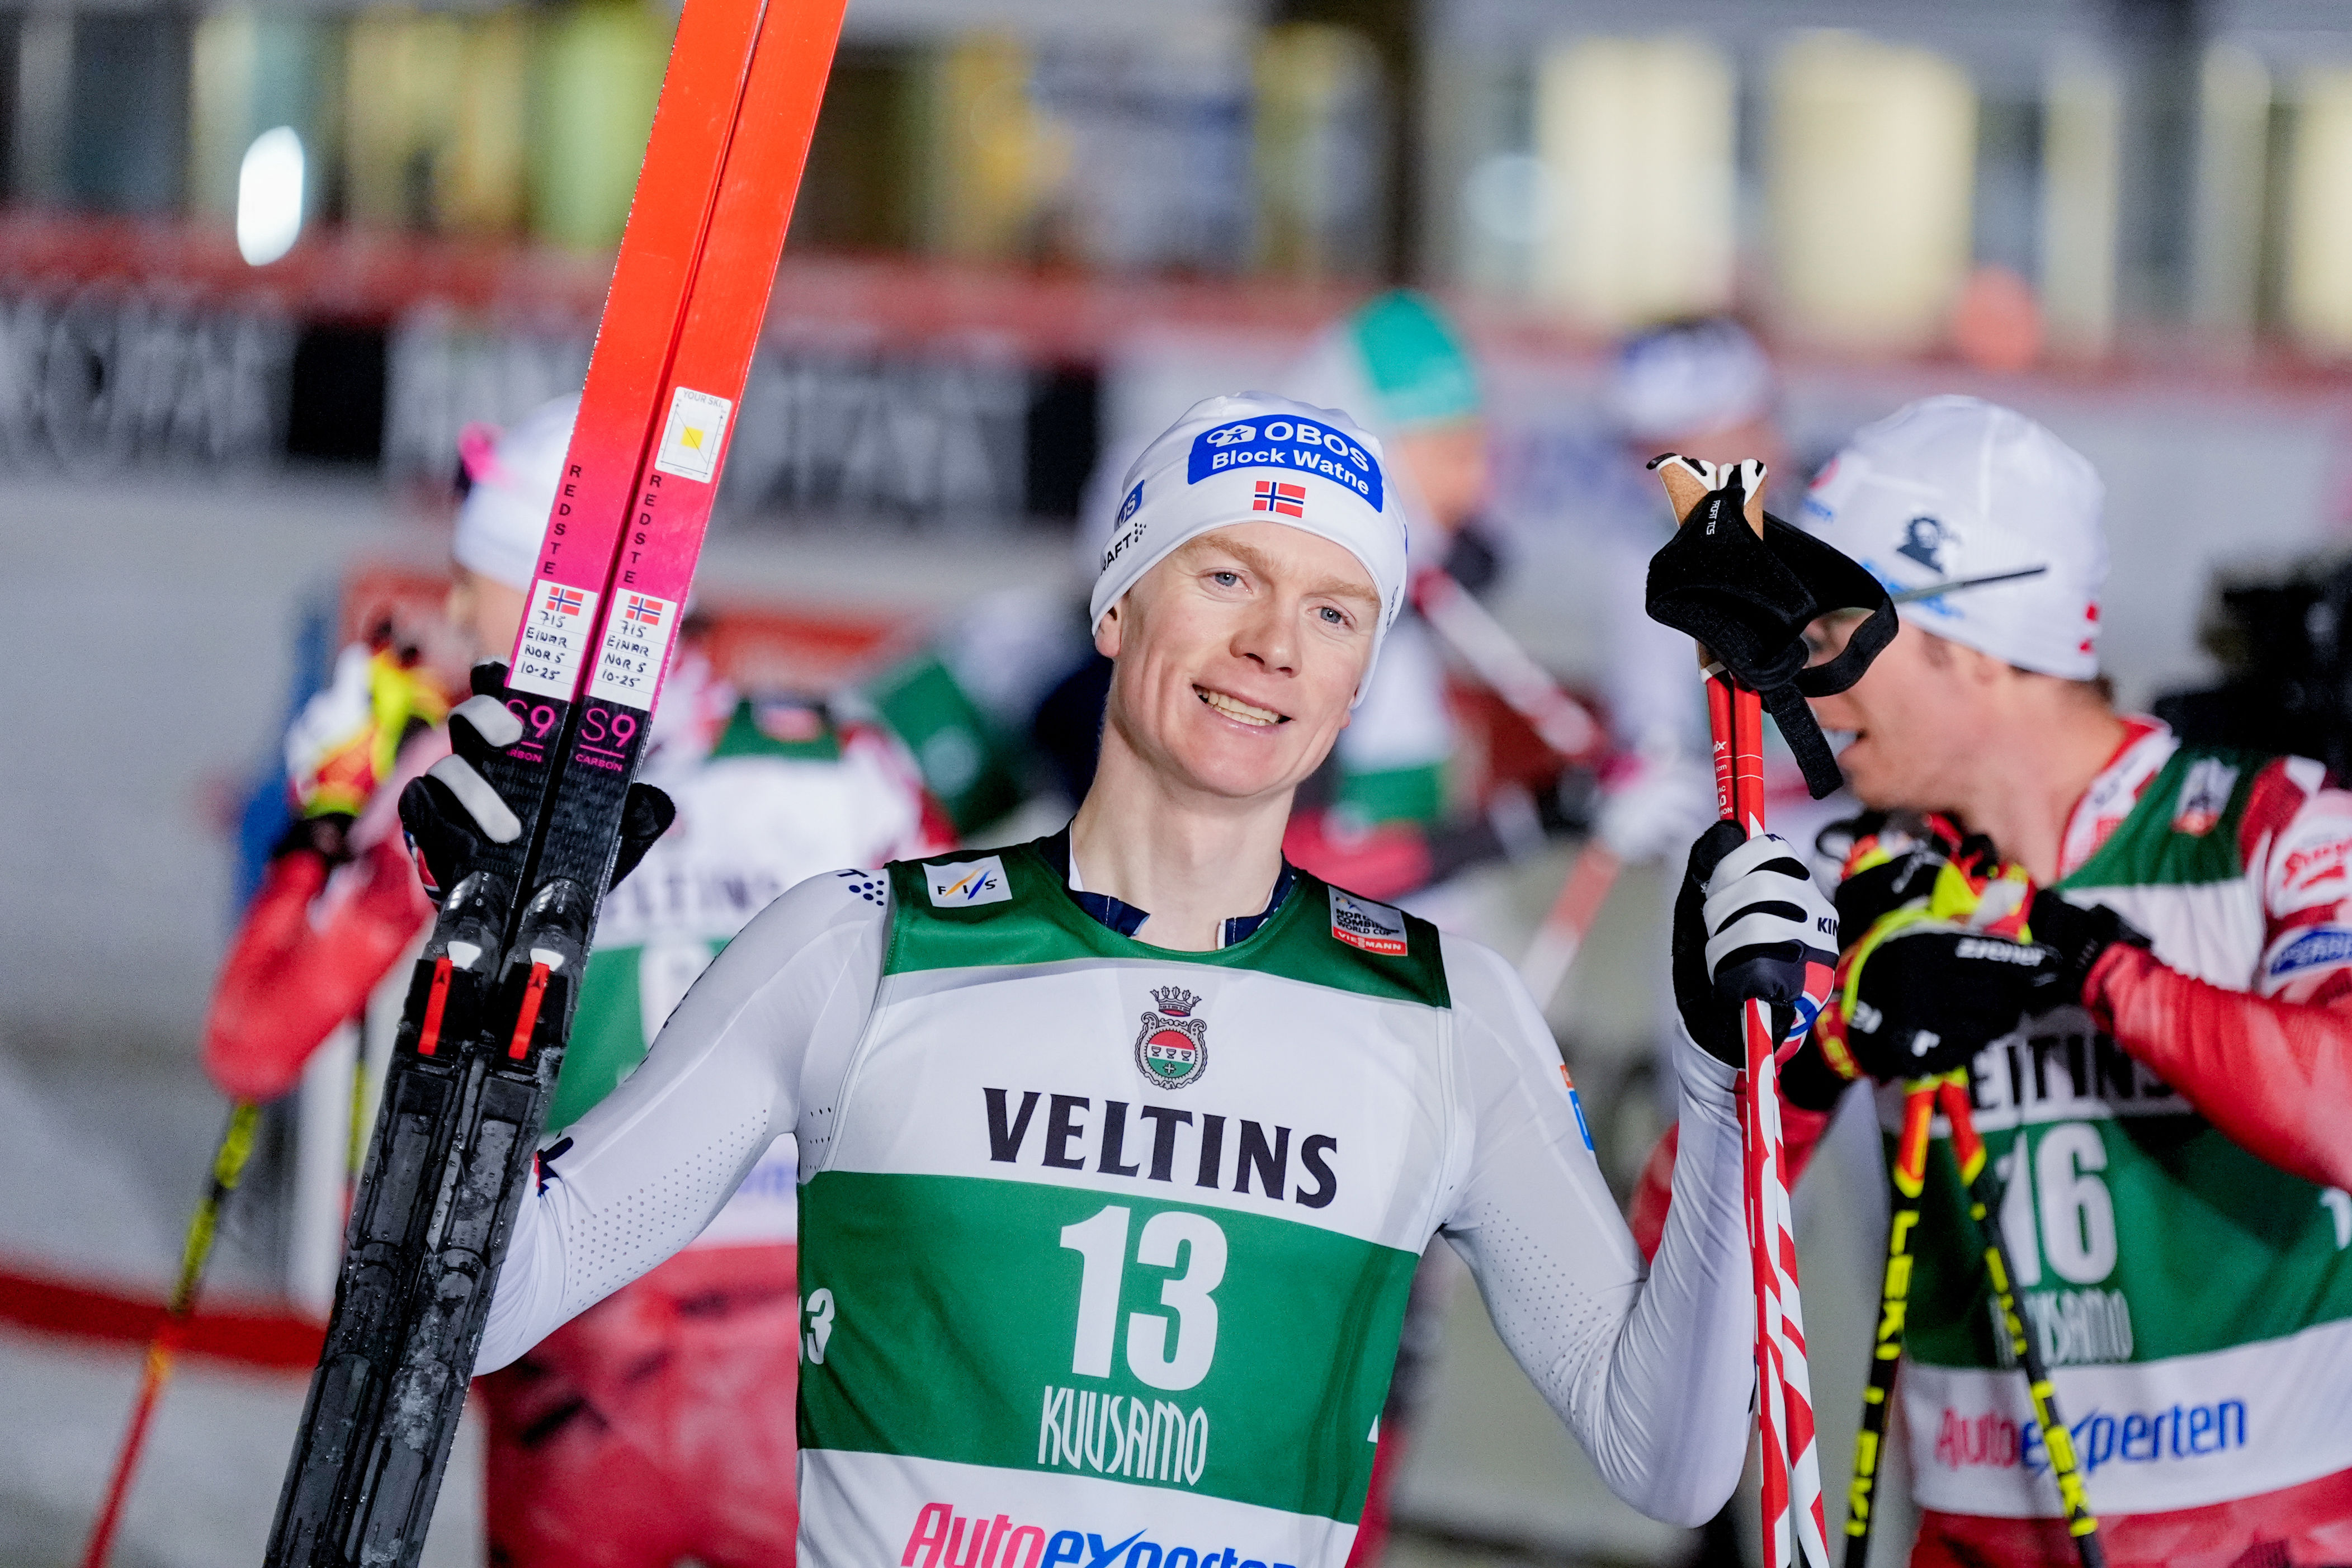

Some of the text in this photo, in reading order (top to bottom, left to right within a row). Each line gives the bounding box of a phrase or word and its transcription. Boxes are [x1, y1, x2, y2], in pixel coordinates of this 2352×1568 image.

[683, 390, 706, 403] YOUR
[1264, 422, 1369, 472] OBOS
[1212, 448, 1369, 495] Block Watne
[1706, 520, 1716, 535] TCS
[538, 610, 566, 628] 715
[620, 619, 646, 637] 715
[525, 644, 550, 660] NOR
[521, 661, 560, 680] 10-25
[604, 653, 646, 673] NOR 5
[602, 669, 640, 687] 10-25
[581, 708, 636, 748] S9
[575, 754, 623, 772] CARBON
[937, 879, 997, 895] FIS
[1337, 921, 1369, 934] WORLD
[983, 1088, 1338, 1208] VELTINS
[1995, 1122, 2118, 1285] 16
[1059, 1205, 1228, 1391] 13
[798, 1288, 835, 1364] 3
[1038, 1385, 1208, 1486] KUUSAMO
